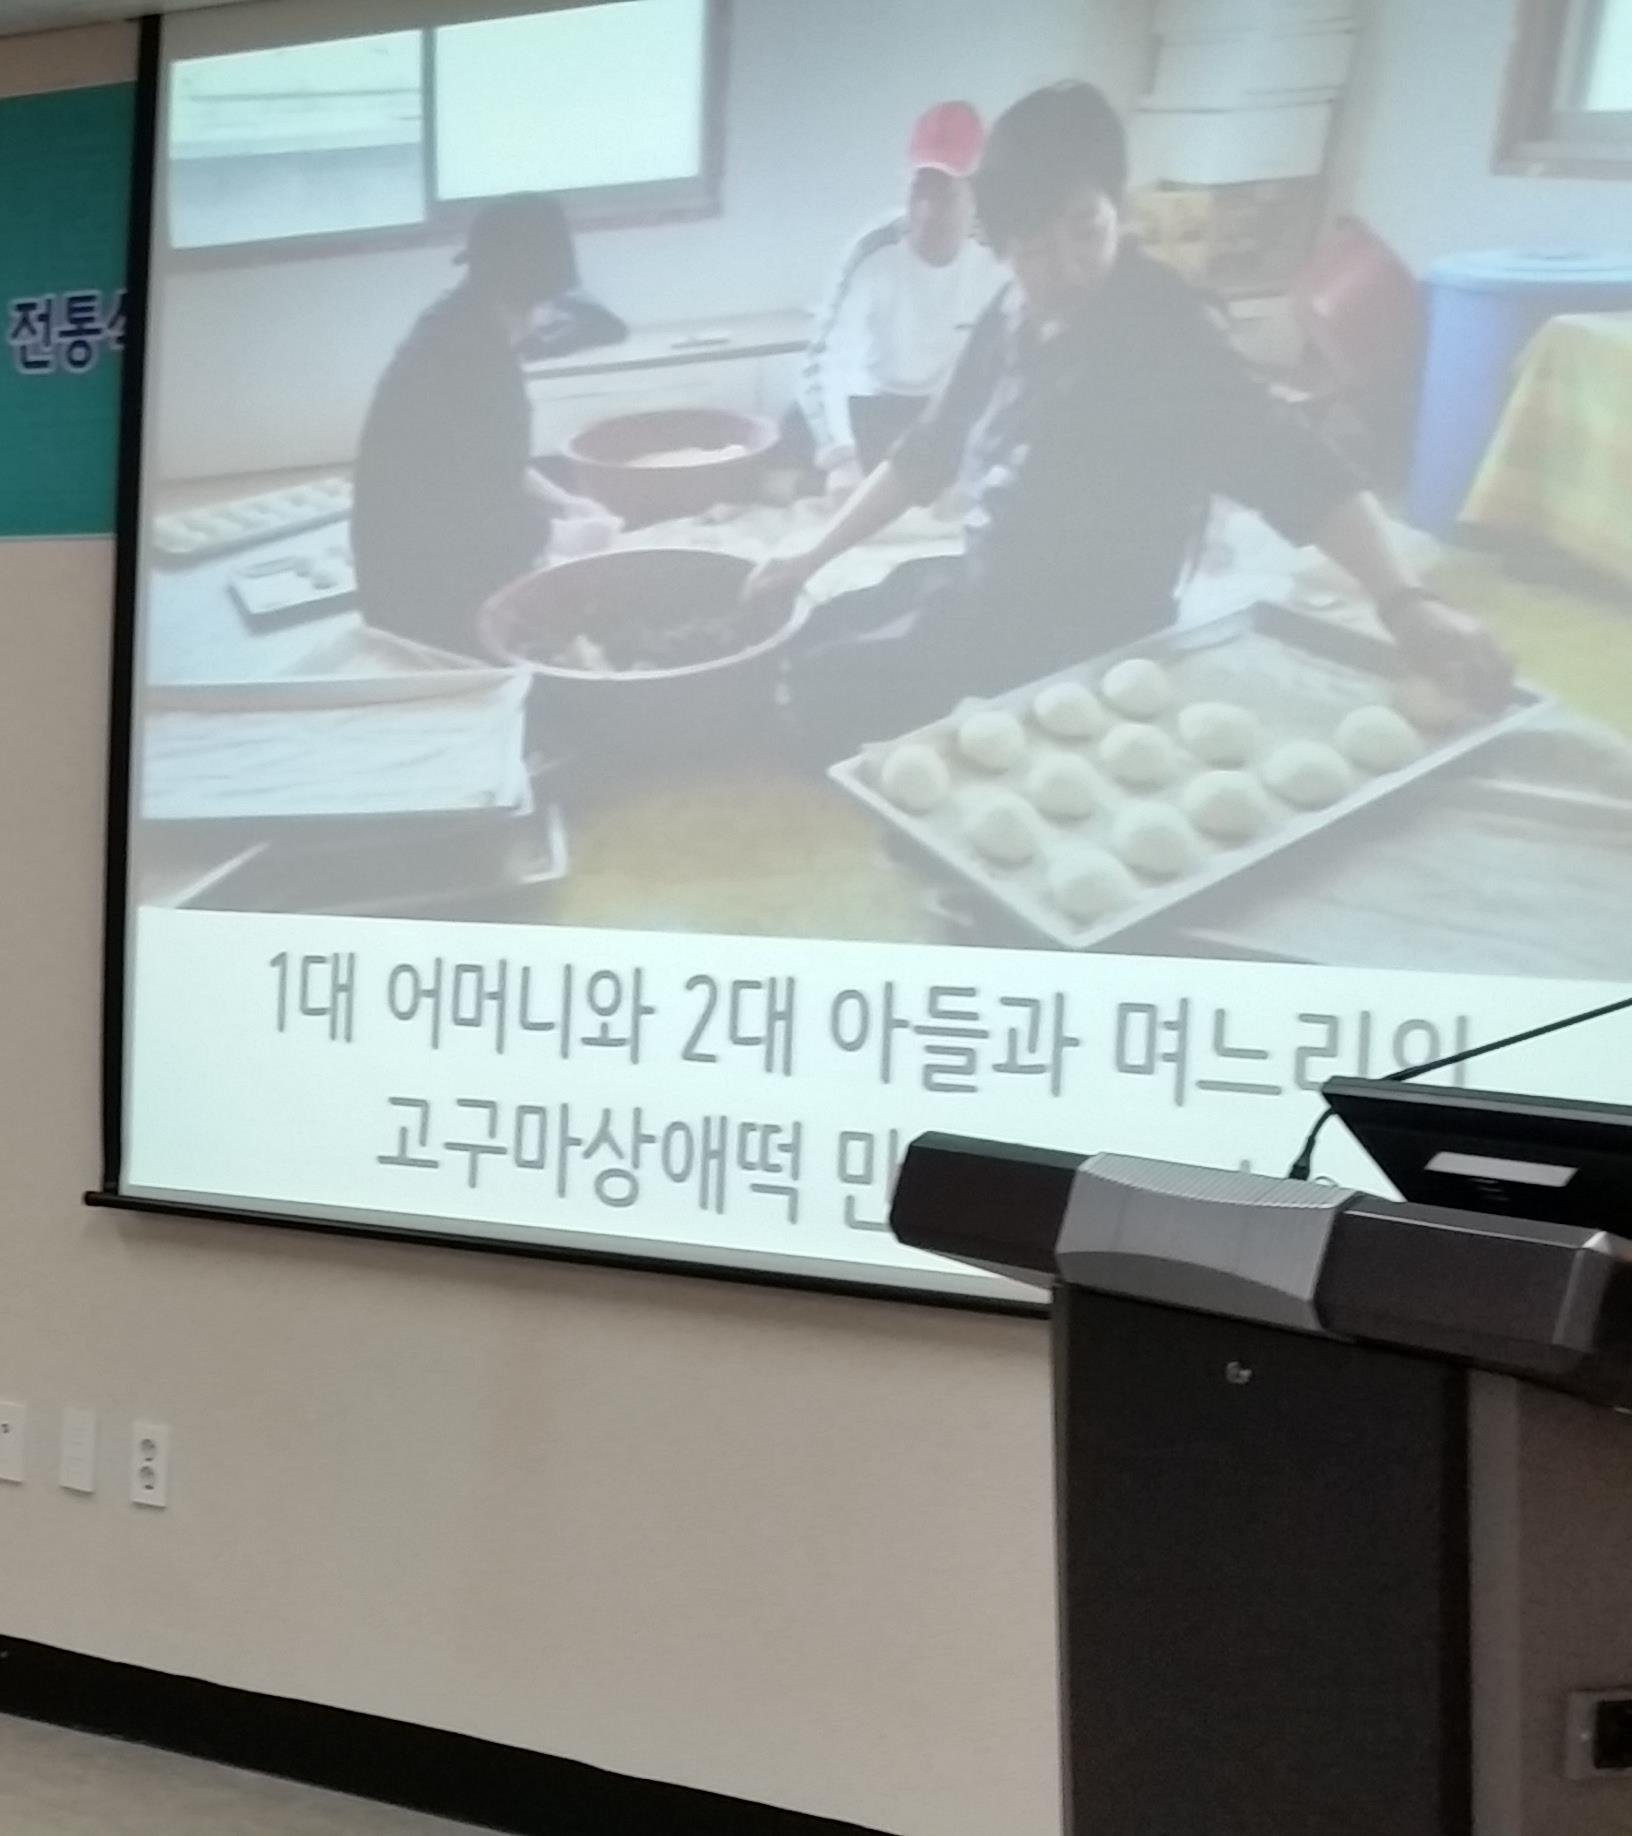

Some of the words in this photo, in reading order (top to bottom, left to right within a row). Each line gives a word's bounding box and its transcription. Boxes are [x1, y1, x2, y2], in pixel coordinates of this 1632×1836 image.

[270, 952, 355, 1043] 1대
[388, 957, 656, 1064] 어머니와
[682, 975, 795, 1076] 2대
[831, 982, 1080, 1097] 아들과
[376, 1096, 802, 1225] 고구마상애떡
